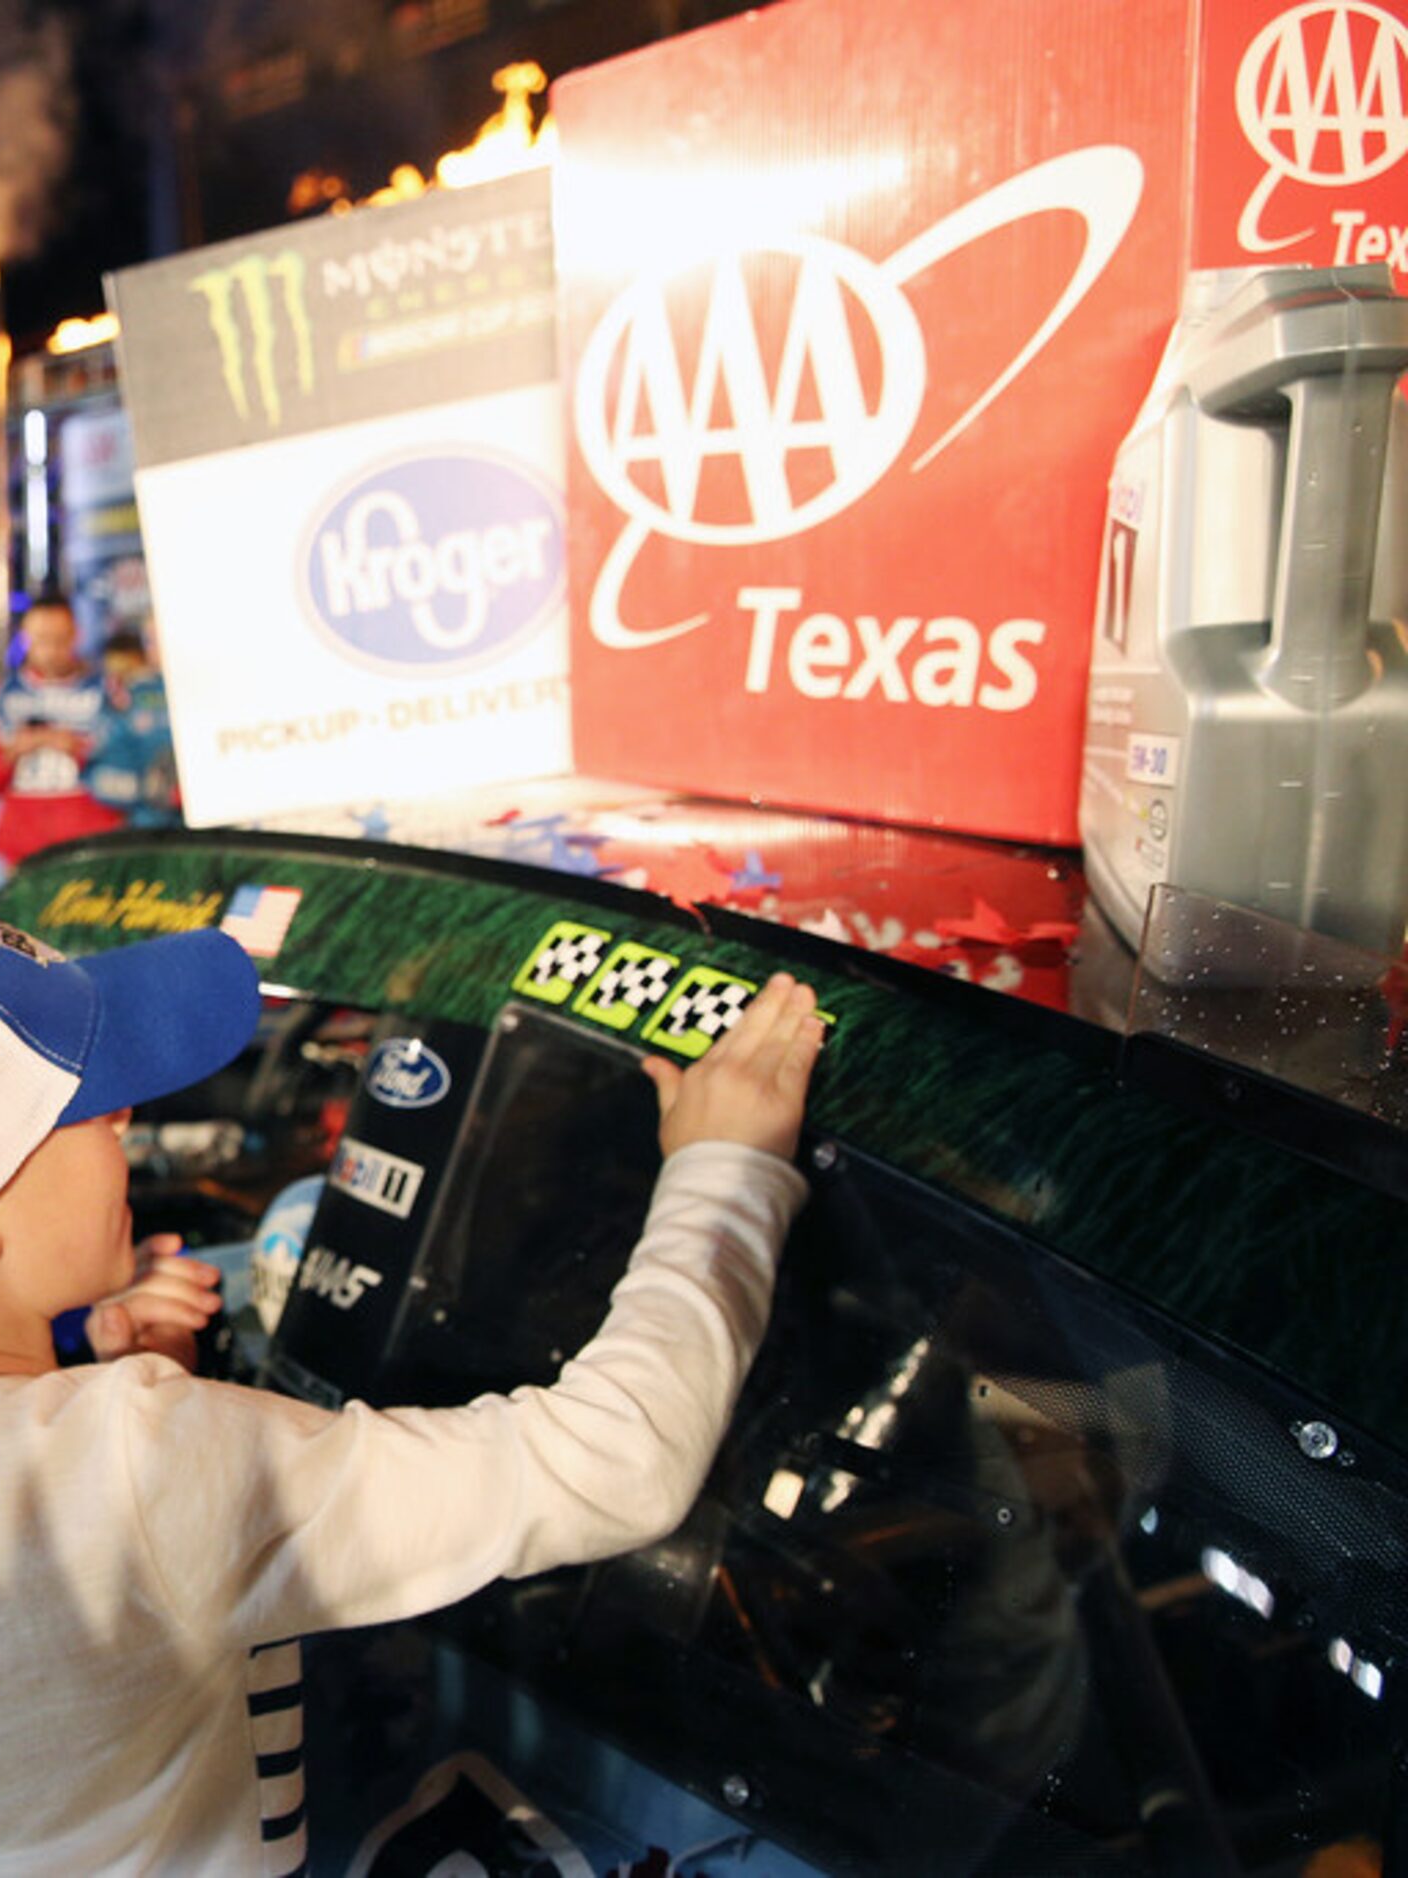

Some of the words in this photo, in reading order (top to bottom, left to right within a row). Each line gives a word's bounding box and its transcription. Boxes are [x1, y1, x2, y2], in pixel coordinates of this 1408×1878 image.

[1255, 3, 1408, 182] AAA
[597, 235, 902, 540] AAA
[318, 488, 553, 651] Kroger
[736, 586, 1047, 712] Texas
